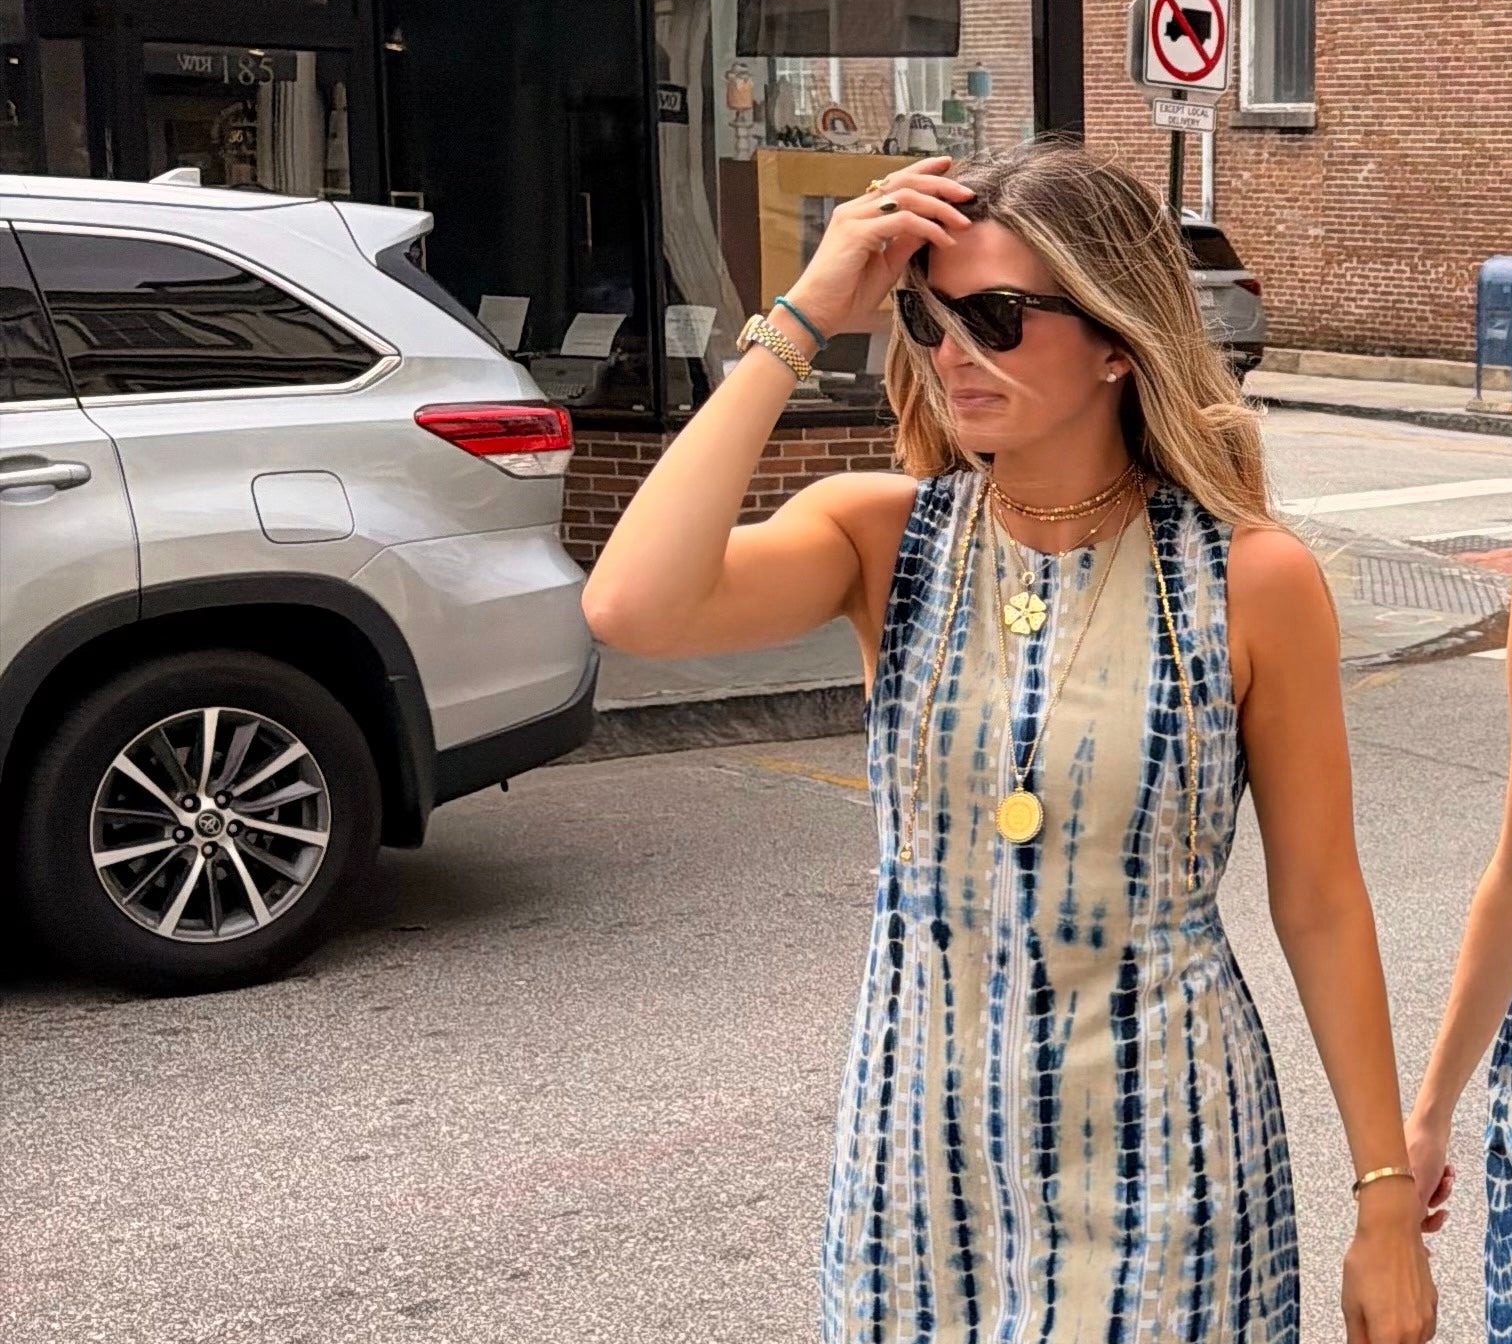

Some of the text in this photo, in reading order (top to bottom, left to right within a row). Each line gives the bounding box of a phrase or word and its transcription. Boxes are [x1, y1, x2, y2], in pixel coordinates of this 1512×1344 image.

[222, 54, 275, 86] 185
[1159, 103, 1209, 118] EXCEPT LOCAL
[1167, 115, 1201, 127] DELIVERY
